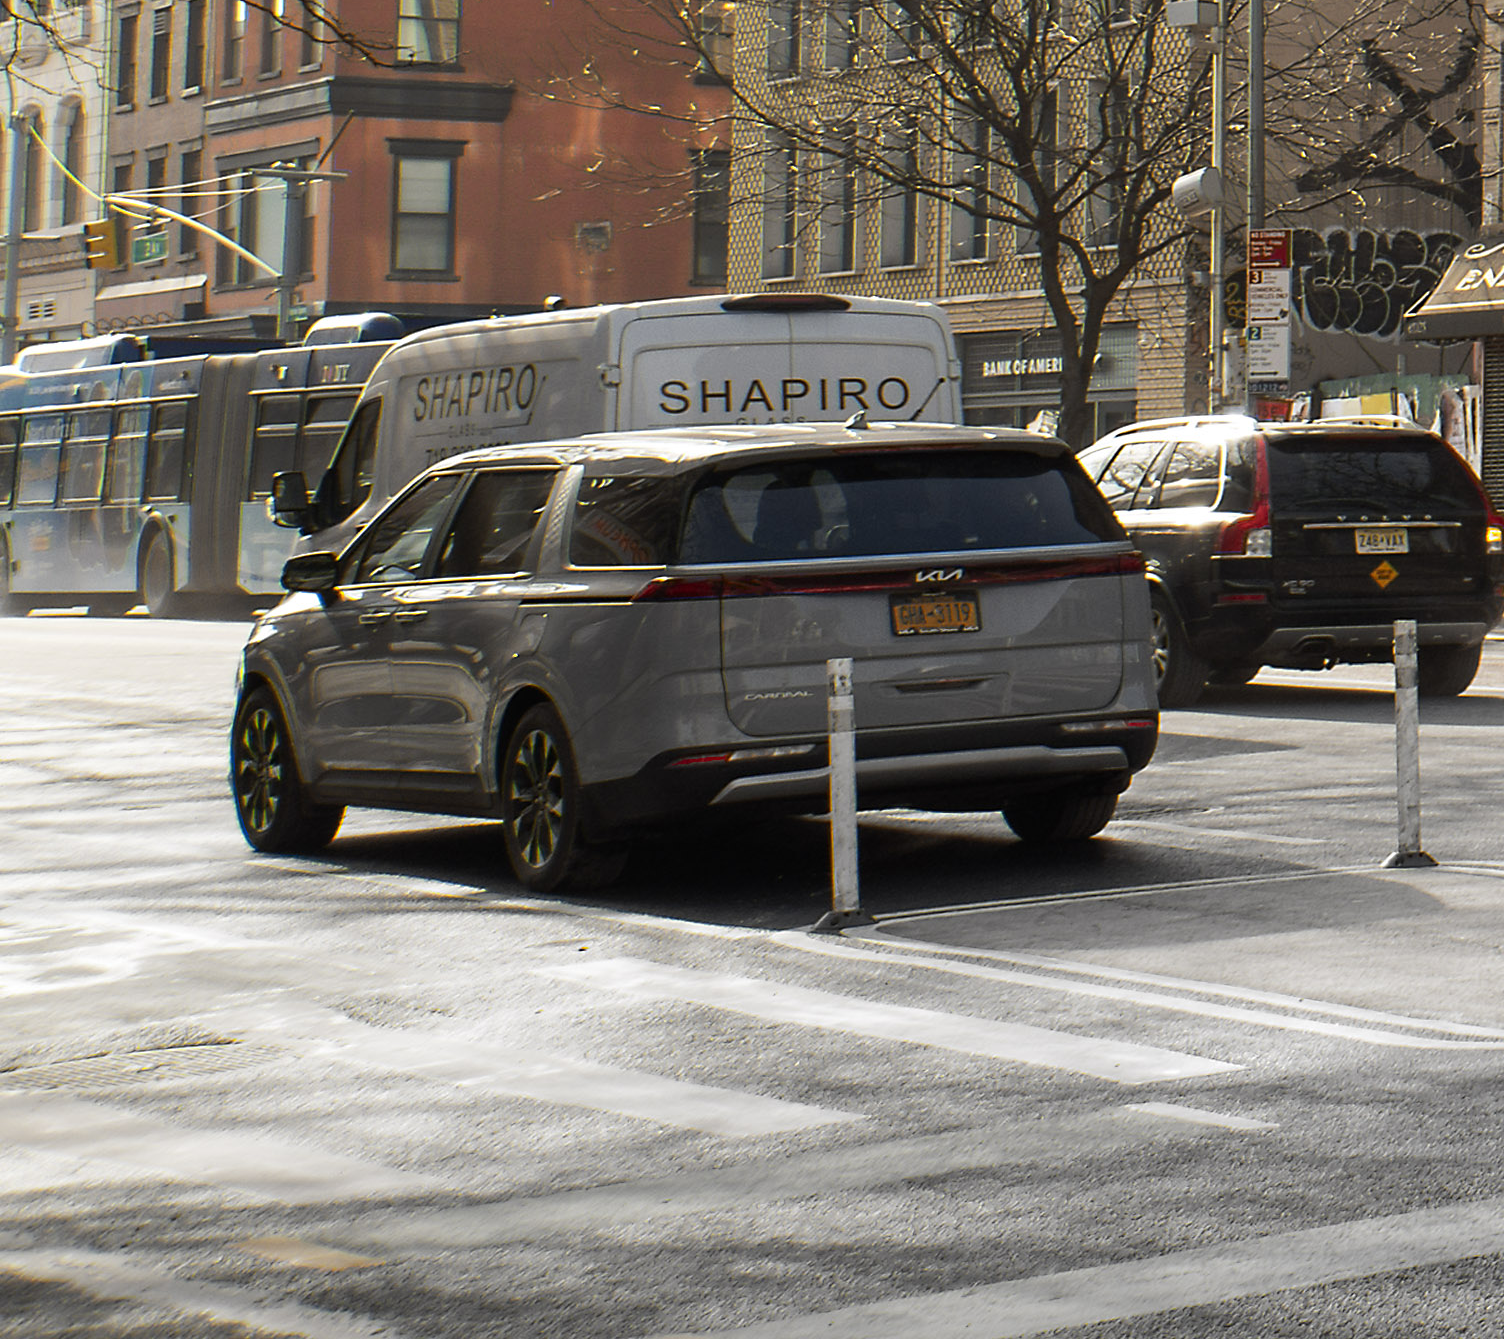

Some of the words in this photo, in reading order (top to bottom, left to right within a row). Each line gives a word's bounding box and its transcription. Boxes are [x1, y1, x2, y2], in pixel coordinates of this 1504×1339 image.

[1252, 270, 1260, 284] 3
[1251, 327, 1260, 339] 2
[982, 361, 1013, 378] BANK
[1013, 360, 1027, 376] OF
[1027, 357, 1063, 375] AMERI
[414, 363, 538, 423] SHAPIRO
[659, 377, 910, 414] SHAPIRO
[1336, 514, 1433, 522] VOLVO
[915, 567, 964, 583] KIA
